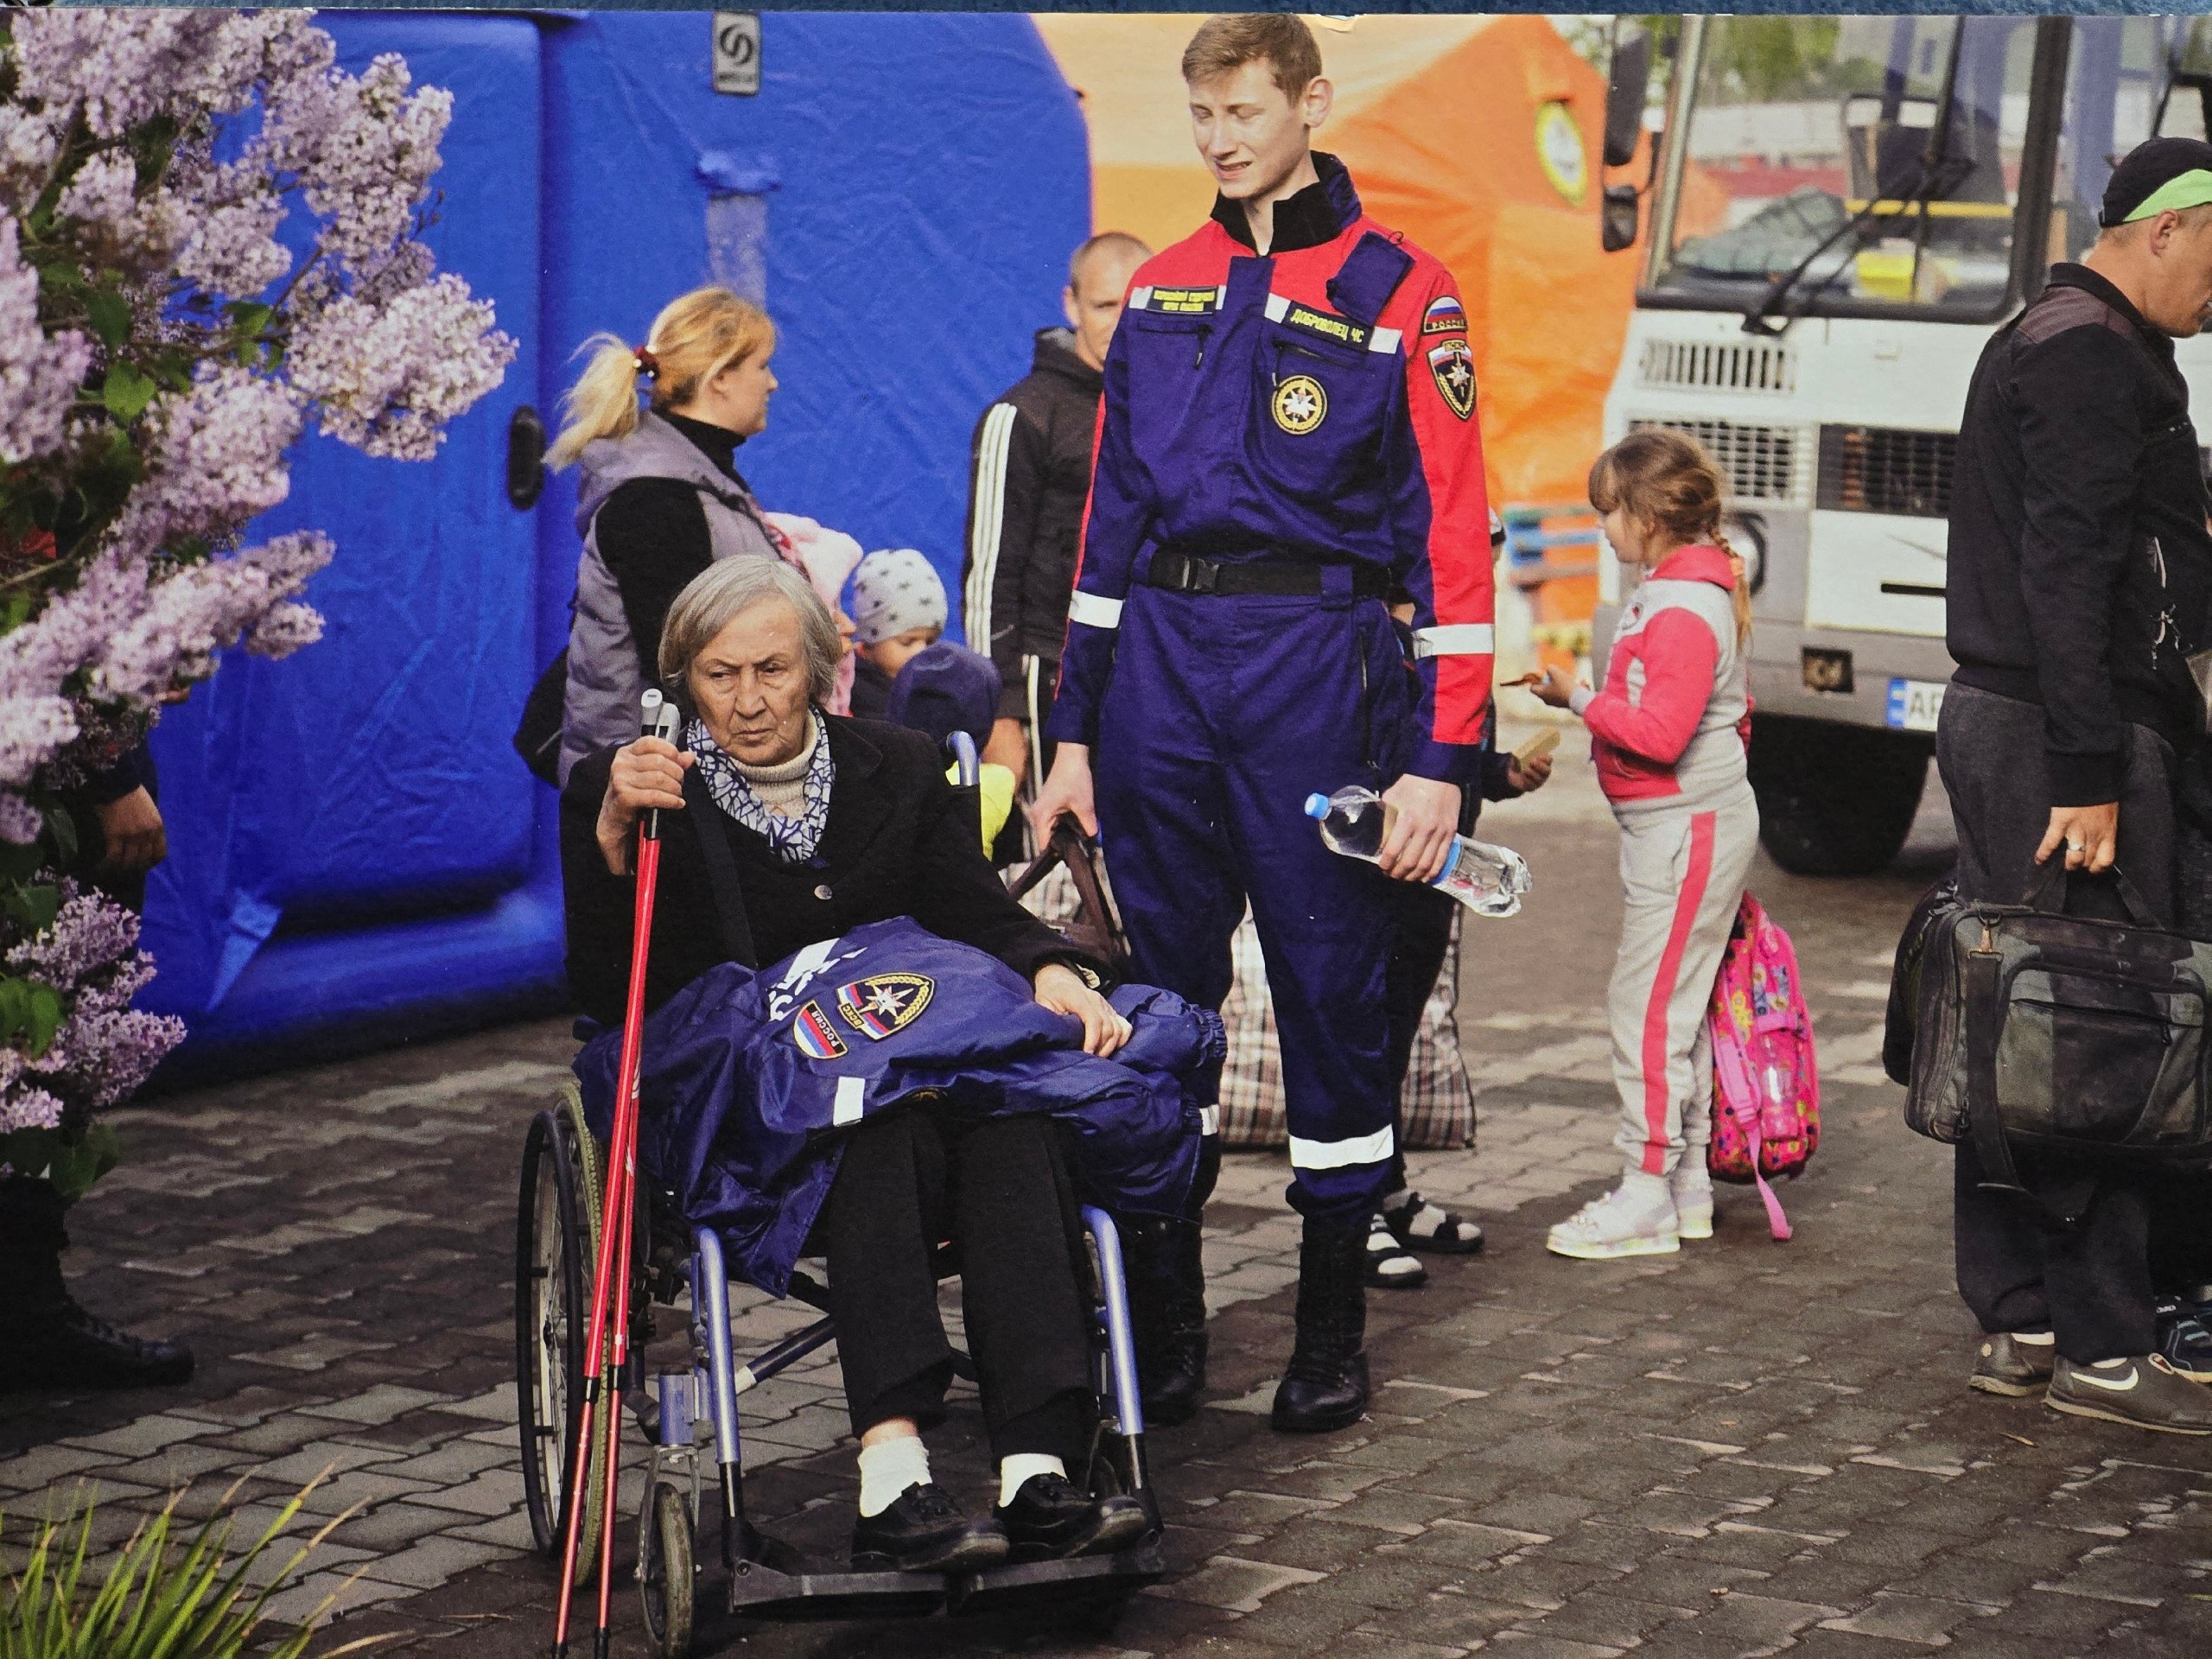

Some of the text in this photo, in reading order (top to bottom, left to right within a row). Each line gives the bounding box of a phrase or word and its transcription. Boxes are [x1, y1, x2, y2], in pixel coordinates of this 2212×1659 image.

[1290, 308, 1364, 343] ДОБРОВОЛЕЦ ЧС
[811, 1010, 840, 1047] РОССИЯ
[842, 1004, 862, 1026] ВСКС
